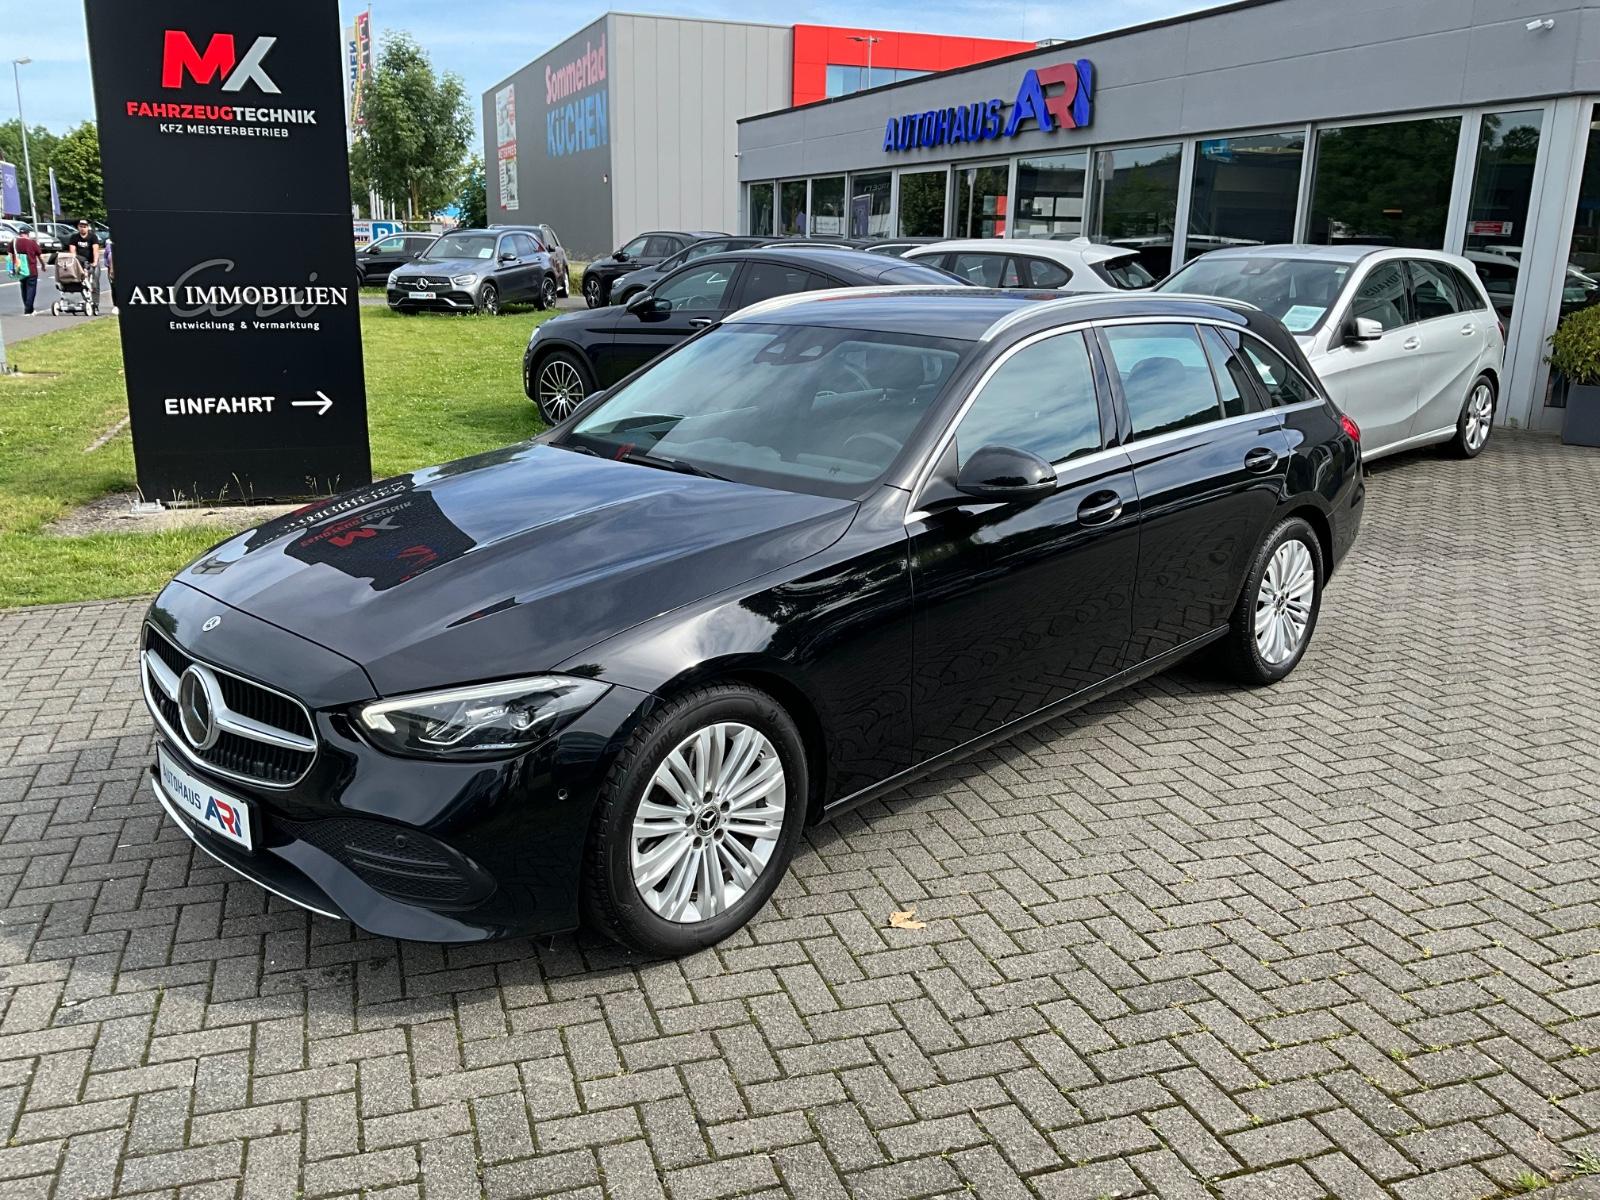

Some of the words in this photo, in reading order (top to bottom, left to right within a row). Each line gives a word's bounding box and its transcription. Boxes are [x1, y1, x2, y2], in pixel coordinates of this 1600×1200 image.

[162, 30, 282, 94] MK
[545, 31, 606, 105] Sommerlad
[126, 101, 317, 125] FAHRZEUGTECHNIK
[546, 89, 608, 159] KÜCHEN
[883, 98, 1003, 153] AUTOHAUS
[1003, 58, 1095, 137] ARI
[160, 123, 183, 134] KFZ
[187, 125, 289, 138] MEISTERBETRIEB
[128, 286, 177, 305] ARI
[184, 286, 348, 306] IMMOBILIEN
[169, 320, 235, 331] Entwicklung
[240, 321, 247, 329] &
[253, 320, 320, 331] Vermarktung
[164, 396, 275, 415] EINFAHRT
[163, 763, 202, 810] AUTOHAUS
[204, 796, 242, 838] ARI
